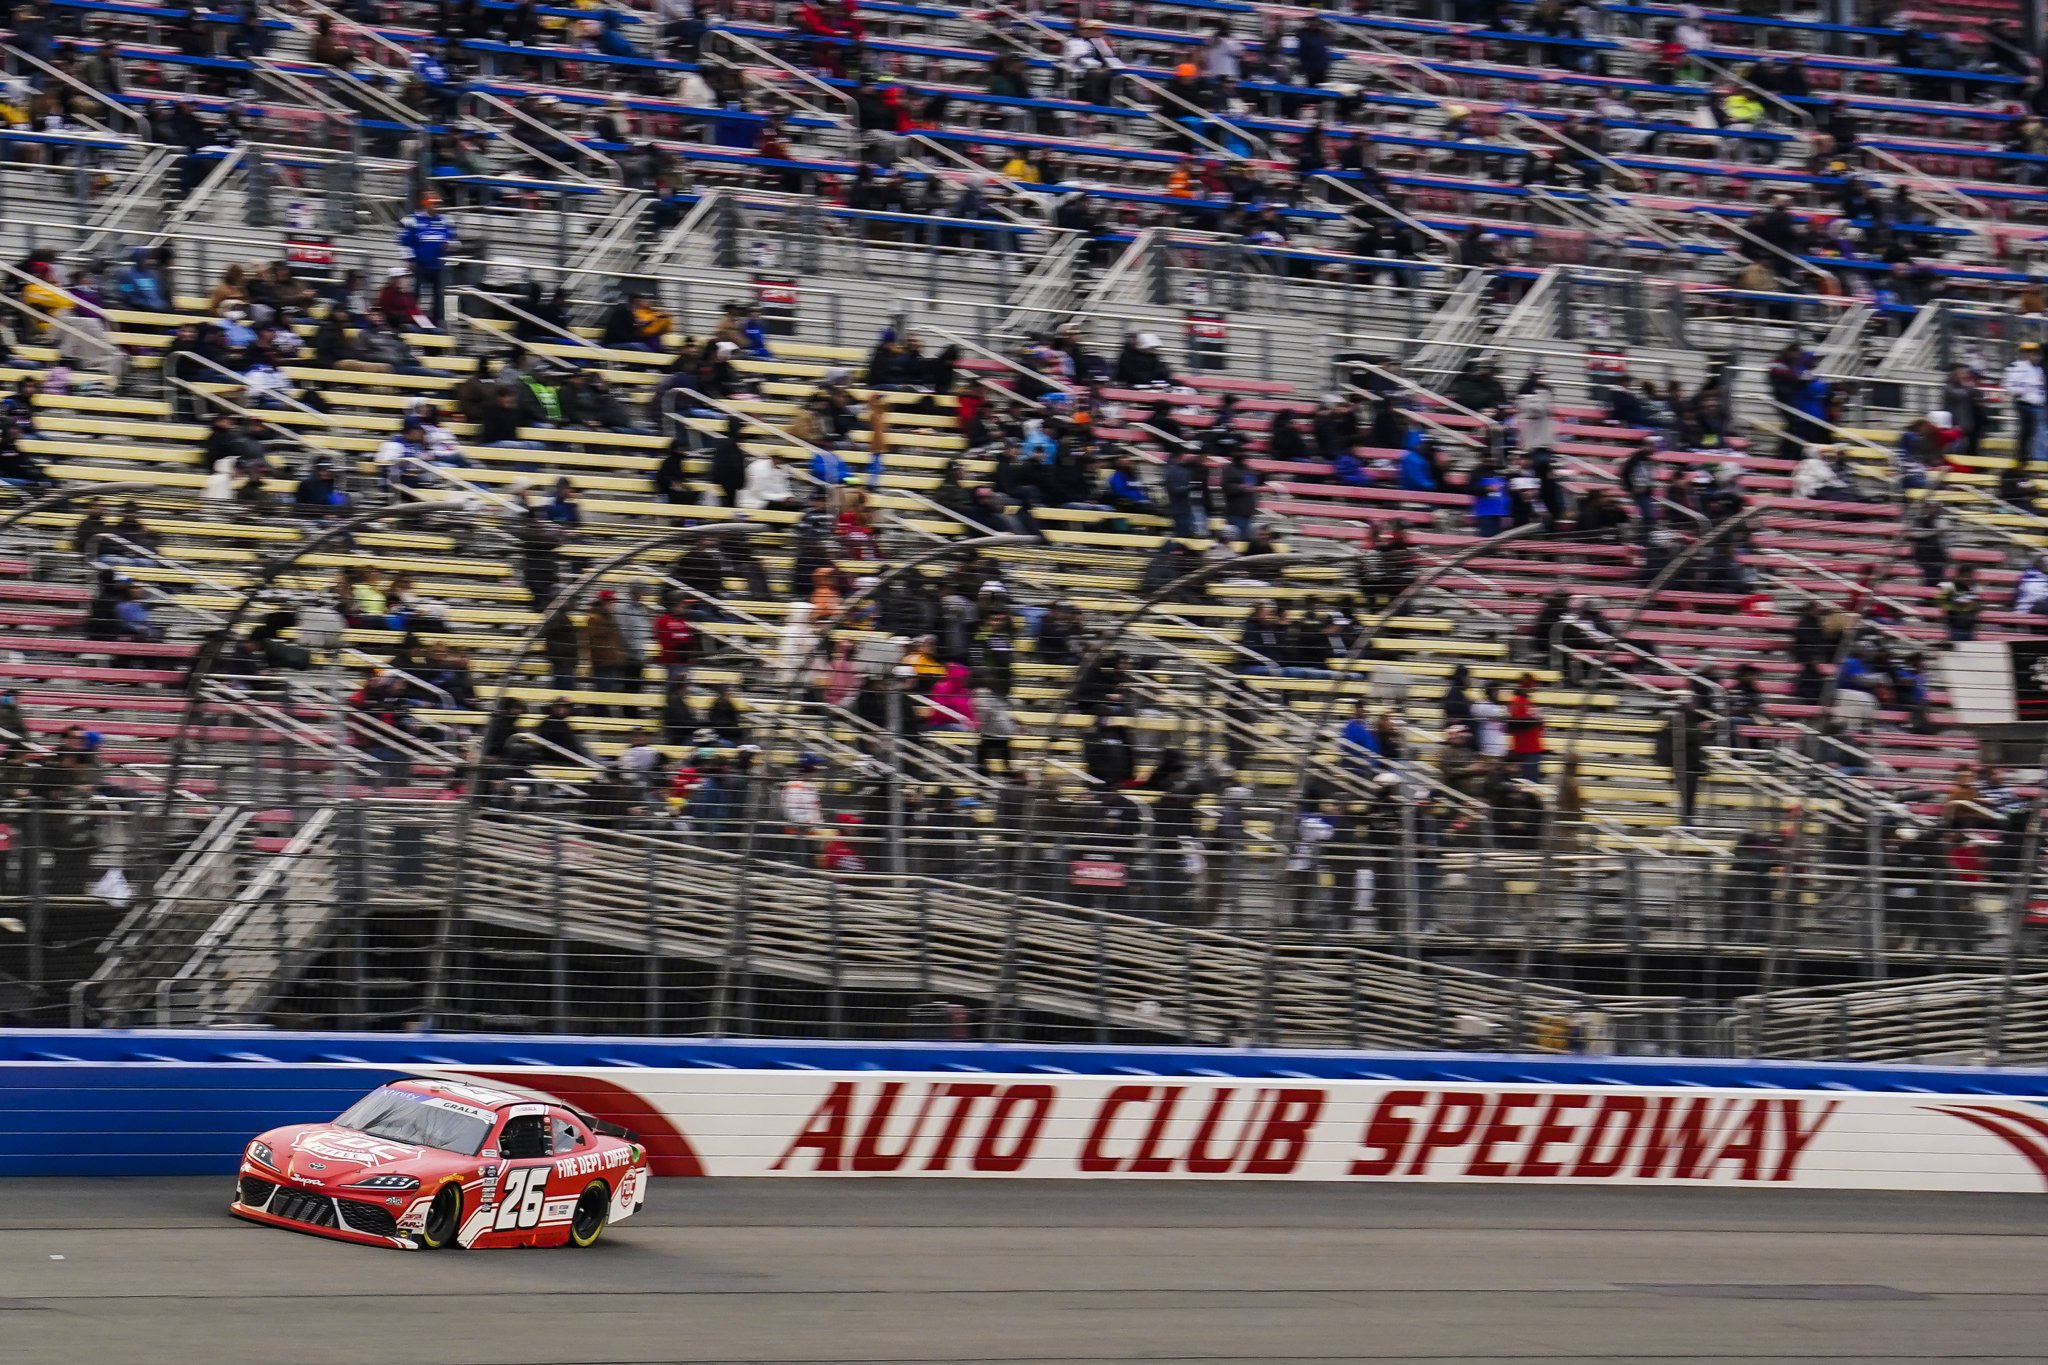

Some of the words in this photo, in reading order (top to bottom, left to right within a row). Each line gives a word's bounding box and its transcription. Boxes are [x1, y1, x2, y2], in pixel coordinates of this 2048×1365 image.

[443, 1102, 479, 1116] GRALA
[770, 1082, 1056, 1171] AUTO
[1077, 1085, 1327, 1174] CLUB
[1349, 1090, 1841, 1181] SPEEDWAY
[555, 1157, 579, 1179] FIRE
[576, 1152, 605, 1175] DEPT.
[602, 1147, 630, 1168] COFFEE
[290, 1173, 325, 1187] Supra
[493, 1165, 552, 1231] 26
